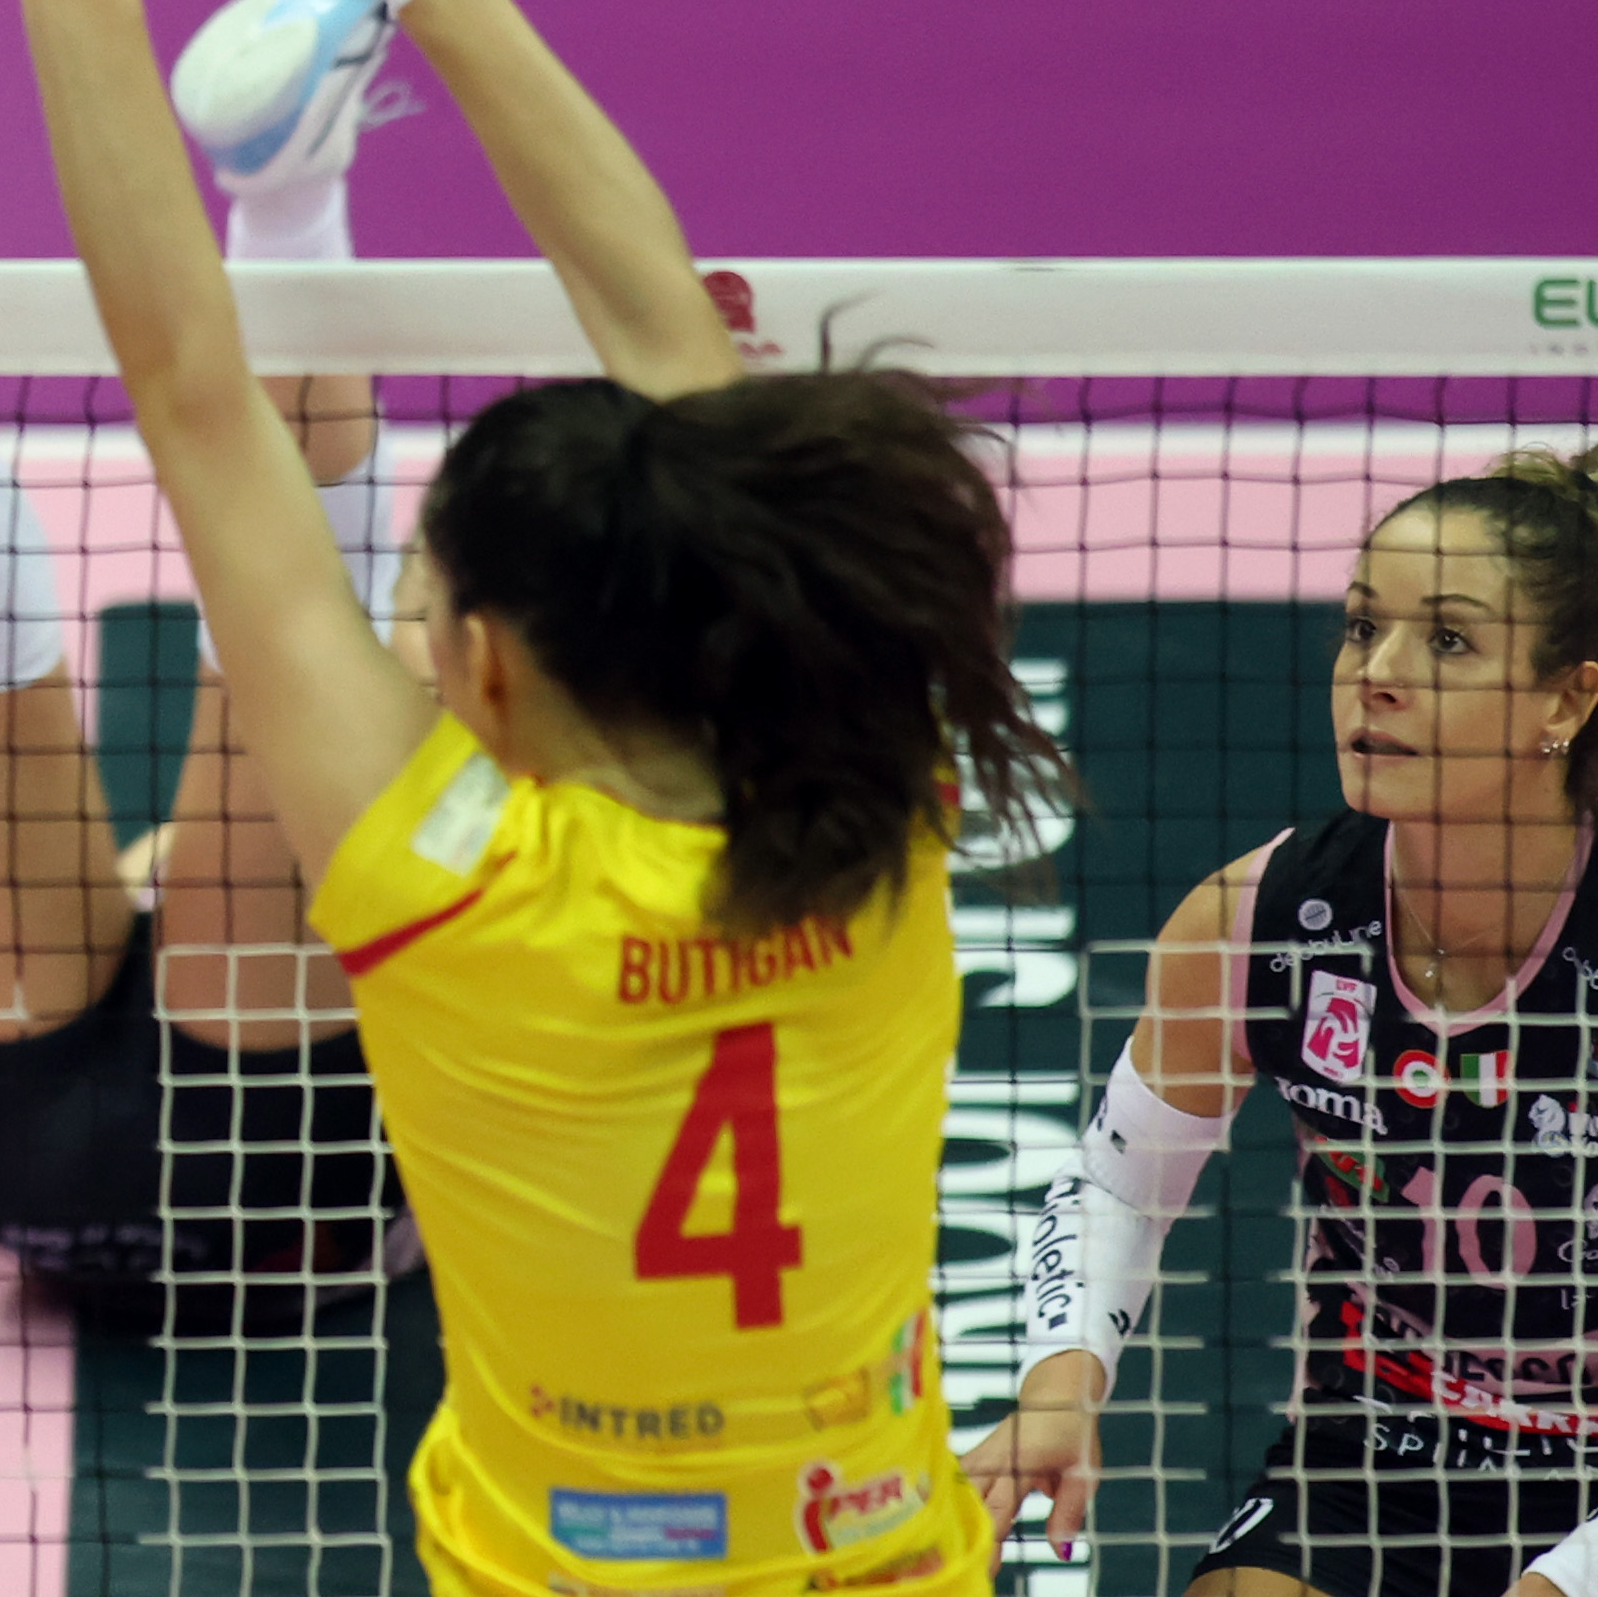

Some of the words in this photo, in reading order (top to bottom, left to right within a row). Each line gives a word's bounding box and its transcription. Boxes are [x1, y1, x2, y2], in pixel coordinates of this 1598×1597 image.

[617, 916, 857, 1006] BUTIGAN
[634, 1021, 802, 1332] 4
[1401, 1166, 1537, 1290] 10
[559, 1395, 726, 1440] INTRED
